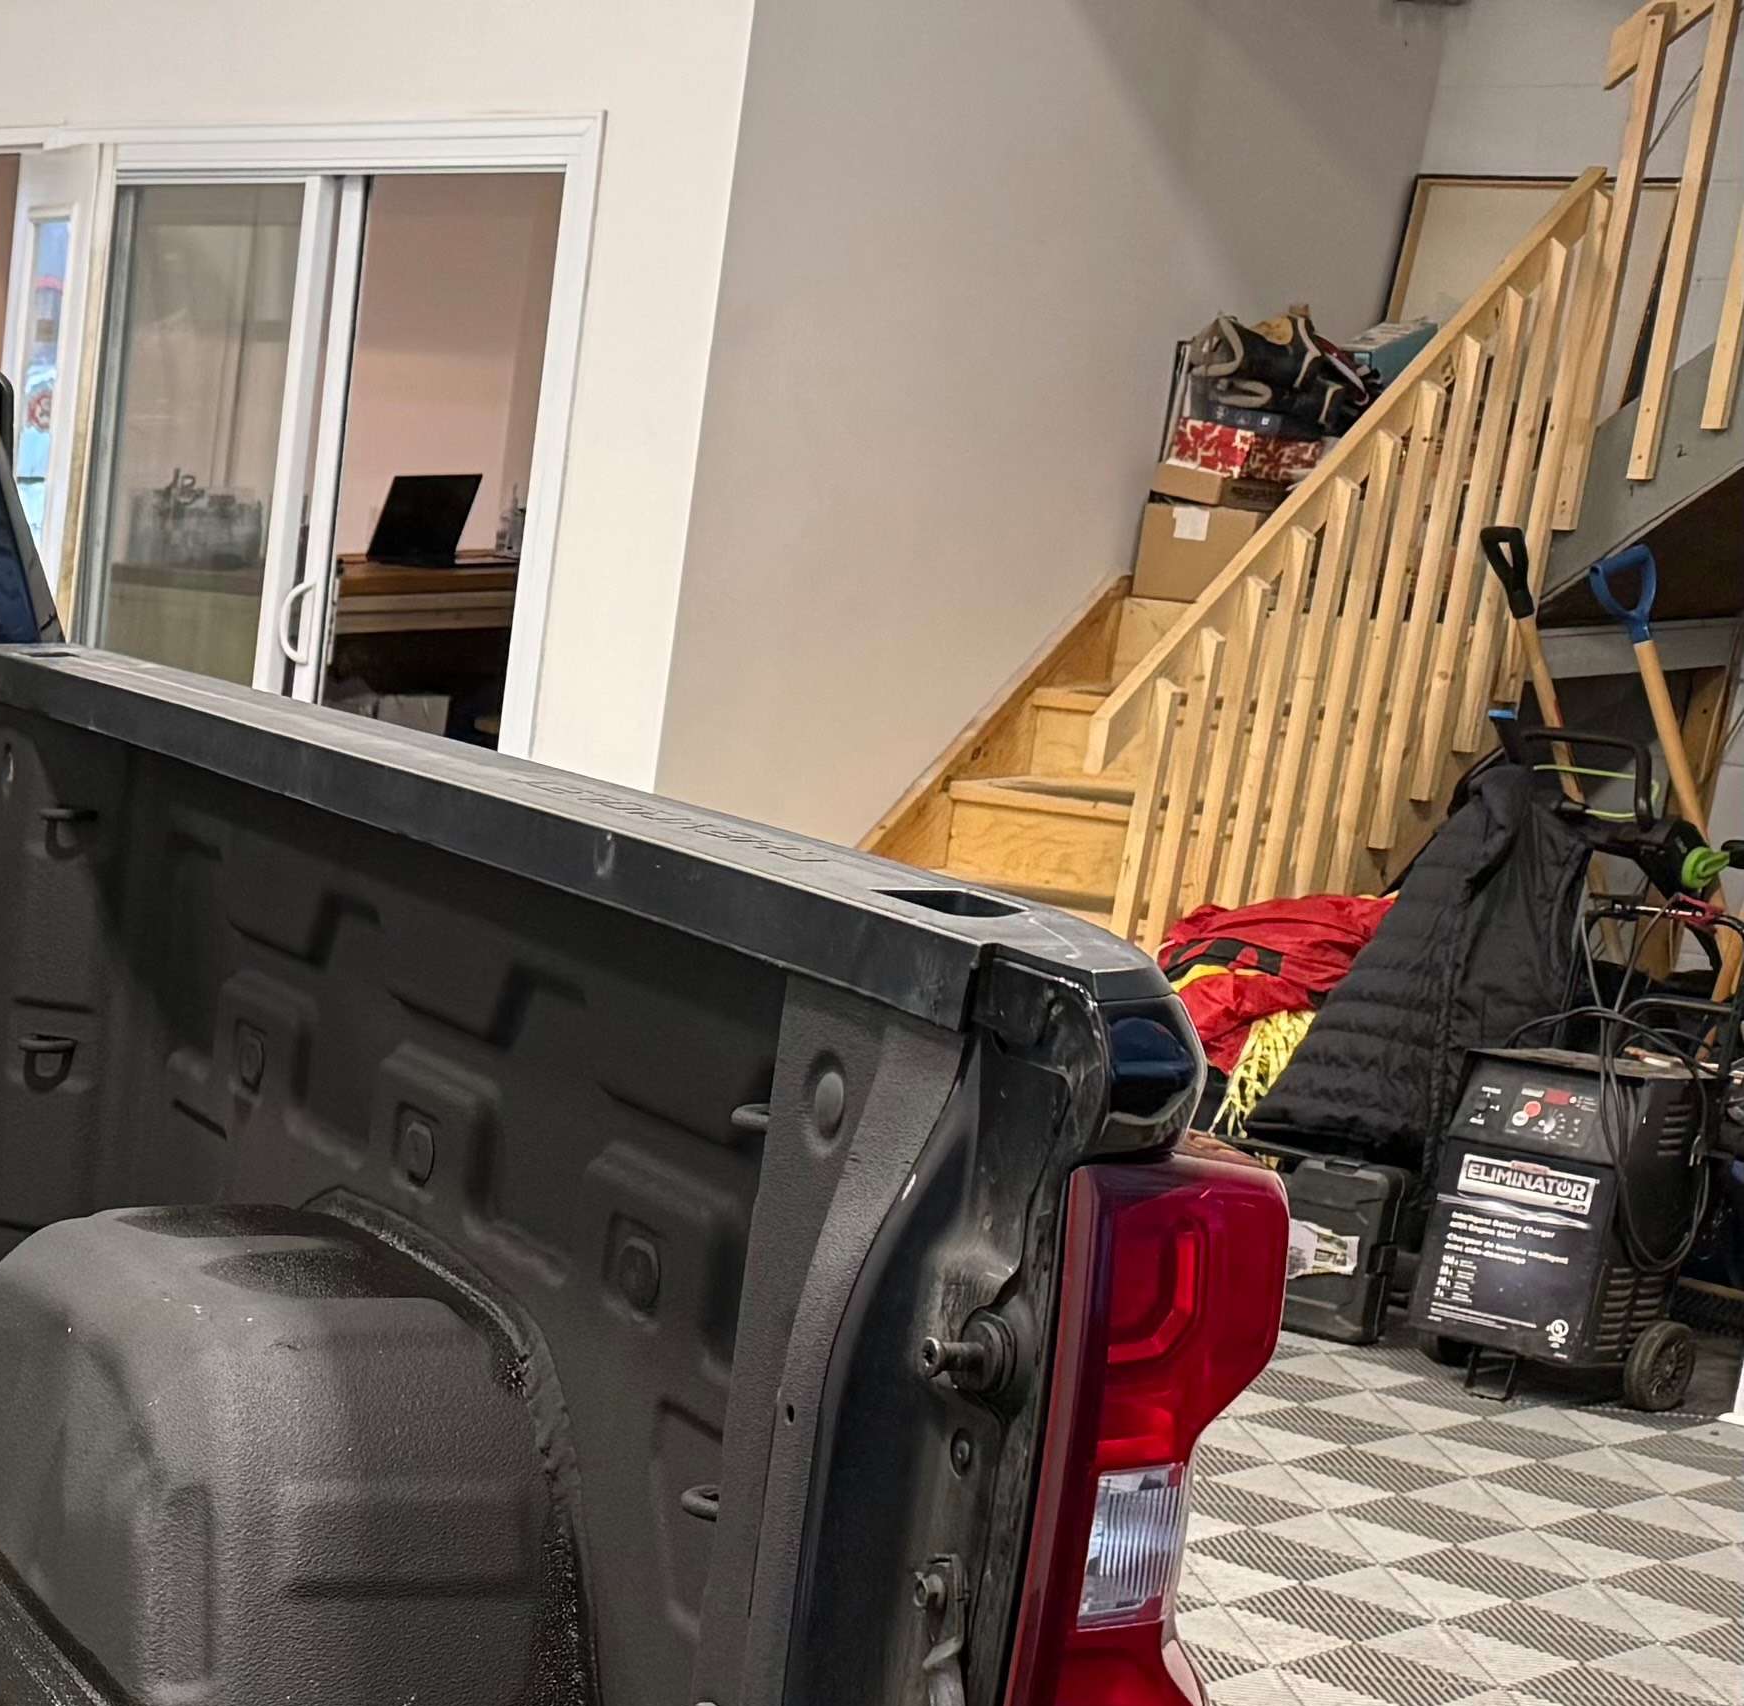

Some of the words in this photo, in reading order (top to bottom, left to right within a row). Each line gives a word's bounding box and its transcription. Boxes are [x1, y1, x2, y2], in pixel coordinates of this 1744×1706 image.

[507, 777, 829, 864] CHEVROLET
[1467, 1163, 1589, 1200] ELIMINATOR
[1469, 1224, 1495, 1235] Engine
[1497, 1229, 1516, 1240] Start
[1493, 1219, 1521, 1232] Battery
[1523, 1226, 1555, 1238] Charger
